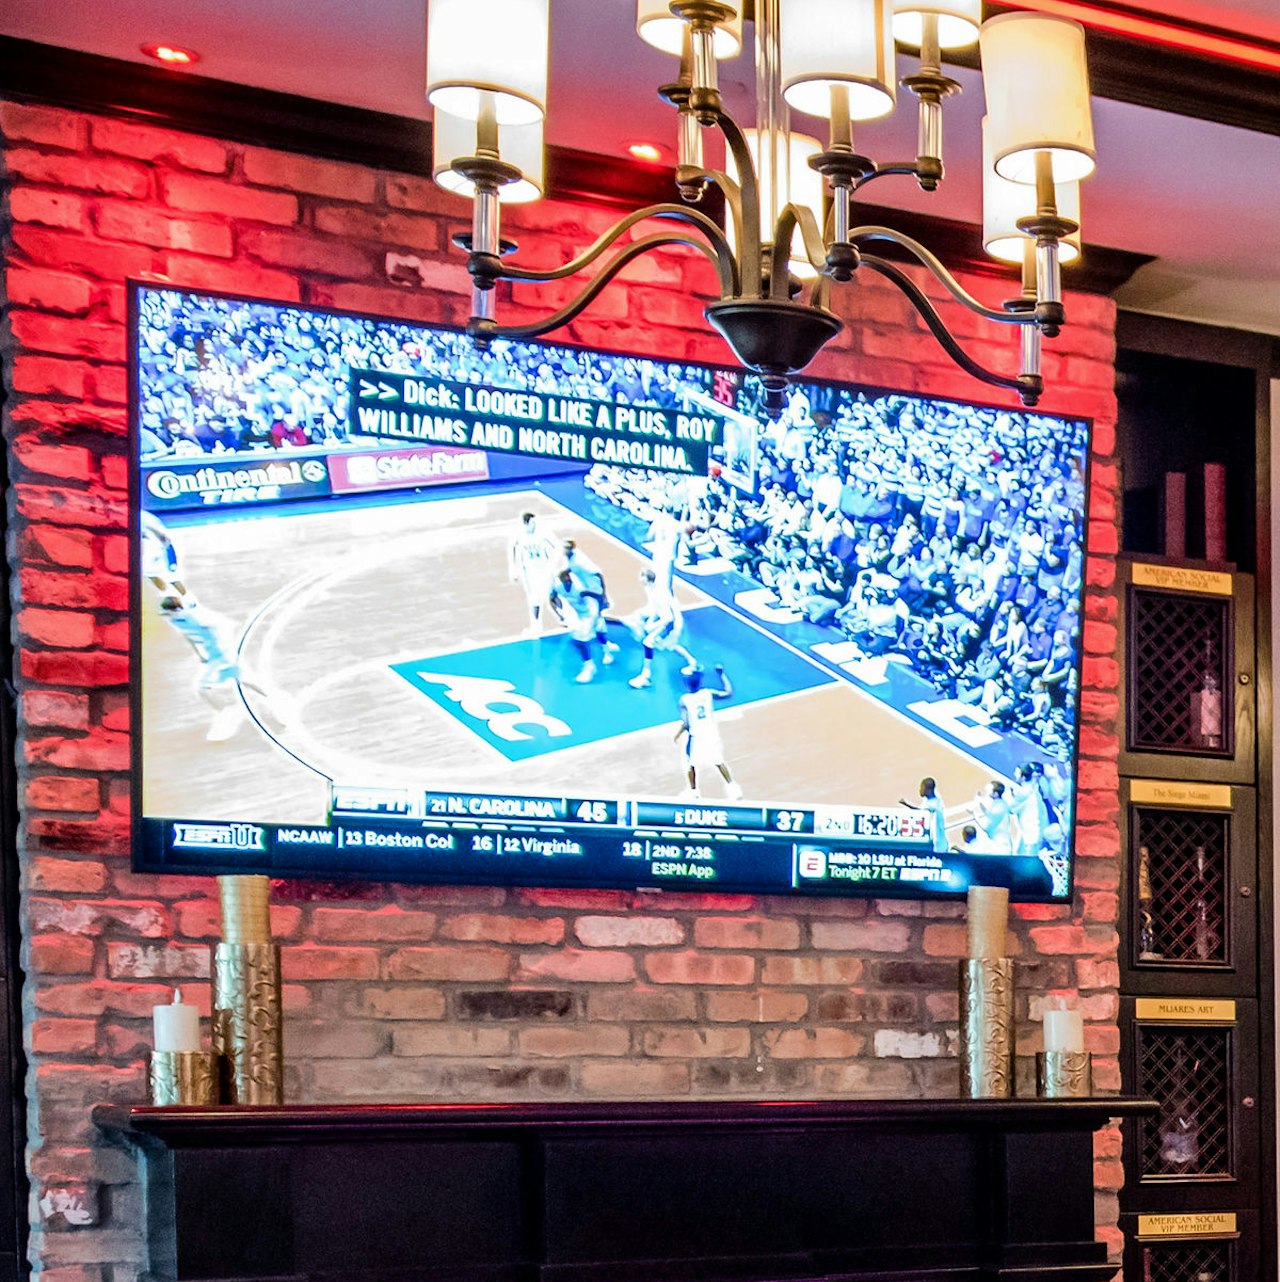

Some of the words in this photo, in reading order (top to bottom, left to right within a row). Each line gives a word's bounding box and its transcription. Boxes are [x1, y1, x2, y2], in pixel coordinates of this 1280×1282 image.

[403, 379, 459, 406] Dick:
[465, 387, 543, 421] LOOKED
[547, 399, 592, 427] LIKE
[596, 405, 612, 429] A
[619, 406, 671, 437] PLUS,
[676, 416, 716, 442] ROY
[358, 408, 467, 446] WILLIAMS
[470, 422, 512, 449] AND
[518, 427, 588, 459] NORTH
[591, 437, 694, 472] CAROLINA.
[148, 461, 303, 499] Continental
[201, 487, 281, 505] TIRE
[416, 671, 573, 741] ACC
[431, 800, 445, 812] 21
[448, 797, 467, 814] N.
[469, 798, 555, 818] CAROLINA
[576, 801, 607, 822] 45
[685, 809, 728, 827] DUKE
[776, 812, 805, 831] 37
[277, 828, 333, 845] NCAAW
[345, 832, 363, 846] 13
[365, 831, 423, 848] Boston
[425, 834, 453, 849] Col
[472, 835, 493, 851] 16
[504, 838, 519, 851] 12
[521, 838, 580, 856] Virginia
[652, 846, 680, 858] 2ND
[873, 853, 894, 866] LSU
[895, 855, 905, 866] at
[907, 855, 942, 867] Florida
[652, 862, 686, 876] ESPN
[688, 864, 713, 880] App
[829, 865, 871, 881] Tonight
[872, 867, 880, 879] 7
[882, 868, 897, 880] ET
[1197, 1006, 1214, 1014] ART
[1148, 1216, 1192, 1225] AMERICAN
[1195, 1215, 1225, 1223] SOCIAL
[1161, 1225, 1175, 1233] VIP
[1177, 1224, 1214, 1232] MEMBER
